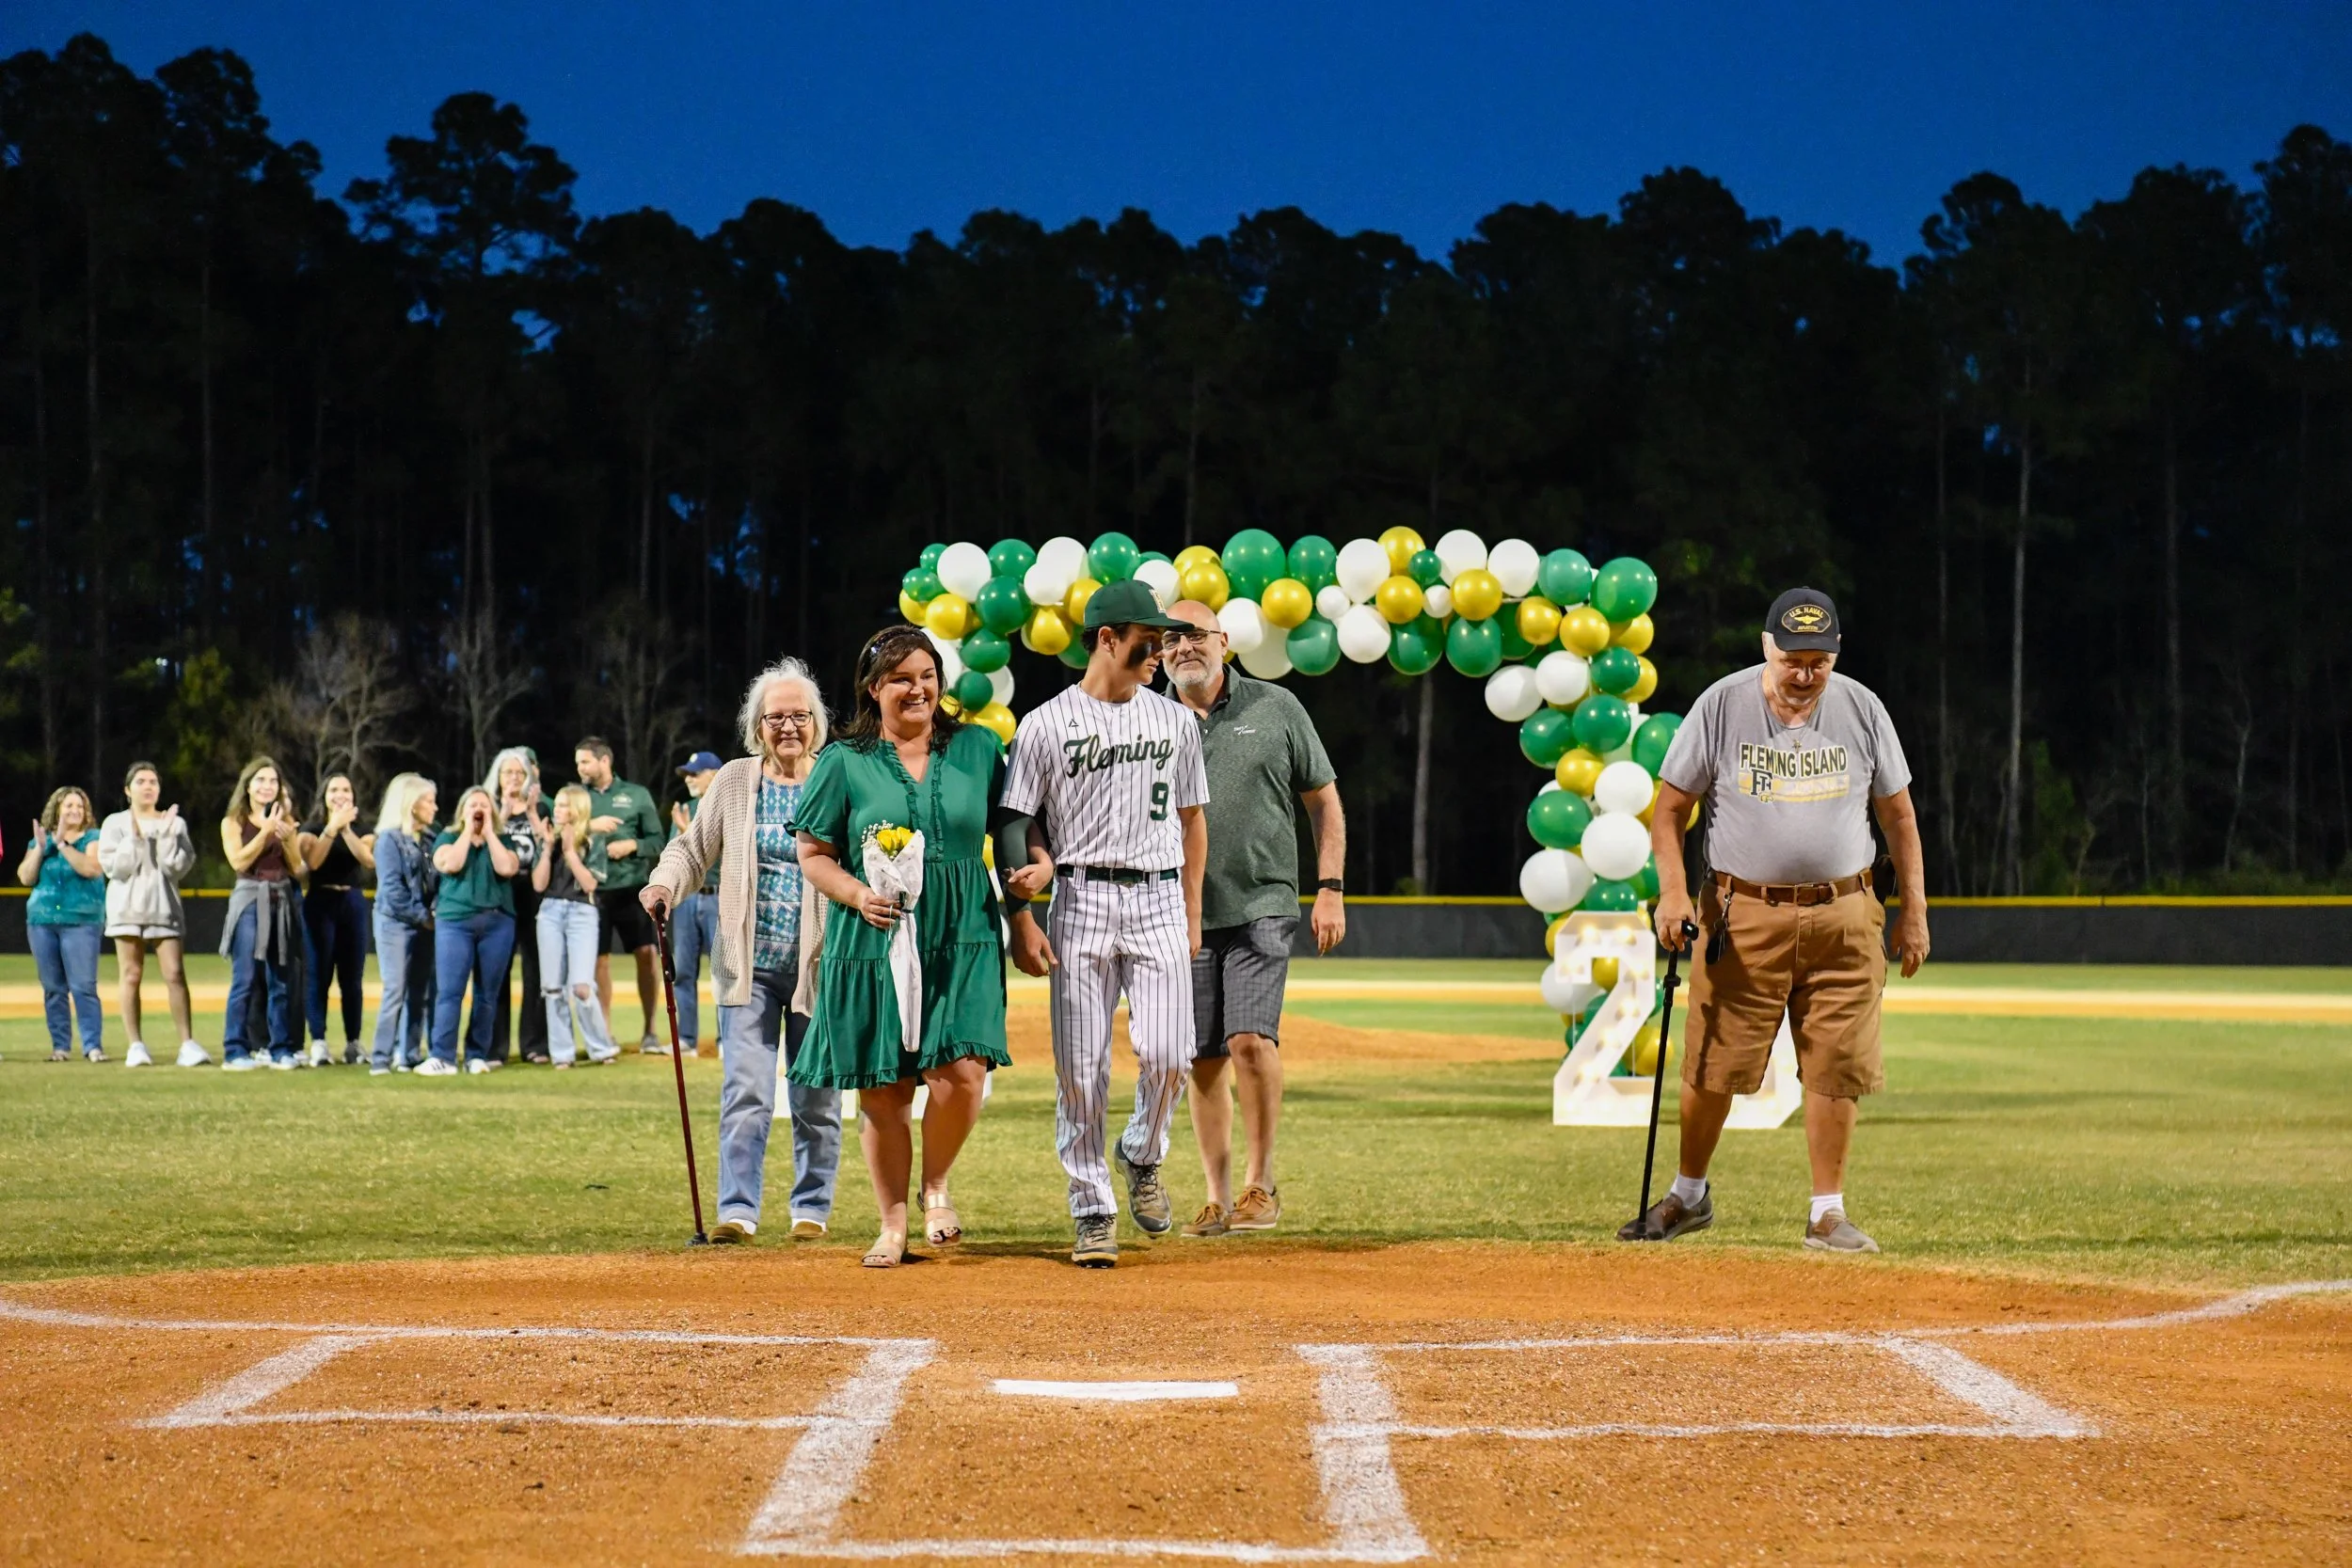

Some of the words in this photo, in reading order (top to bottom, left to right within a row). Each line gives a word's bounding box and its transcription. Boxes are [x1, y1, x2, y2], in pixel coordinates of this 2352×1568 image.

[1804, 607, 1823, 618] NAVAL
[1063, 734, 1174, 778] Fleming
[1740, 744, 1796, 777] FLEMING
[1800, 746, 1847, 776] ISLAND
[1150, 782, 1169, 820] 9
